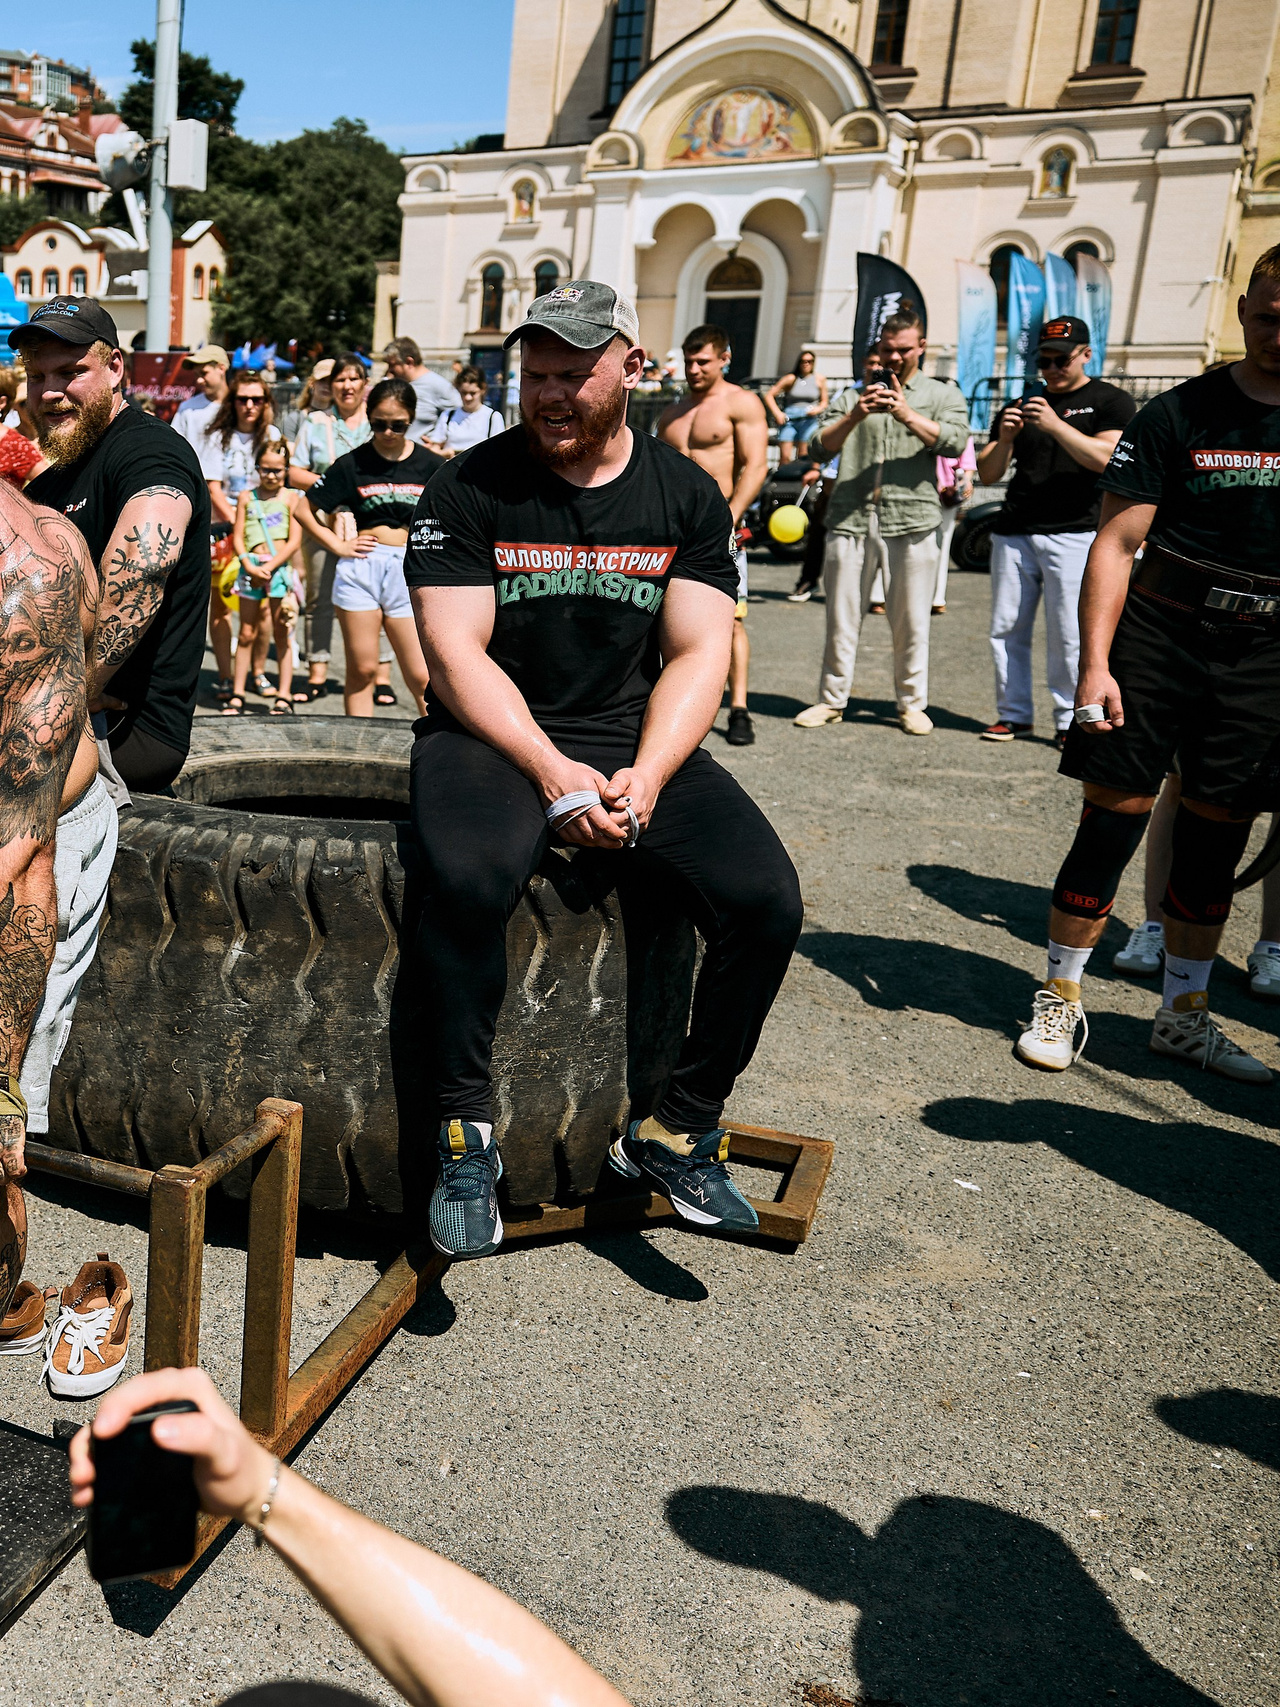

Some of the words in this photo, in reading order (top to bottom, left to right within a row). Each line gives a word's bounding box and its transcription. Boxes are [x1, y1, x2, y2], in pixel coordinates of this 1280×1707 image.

[1194, 453, 1261, 468] СИЛОВОЙ
[494, 546, 574, 569] СИЛОВОЙ
[576, 551, 668, 571] ЭСКСТРИМ
[1065, 892, 1096, 906] SBD
